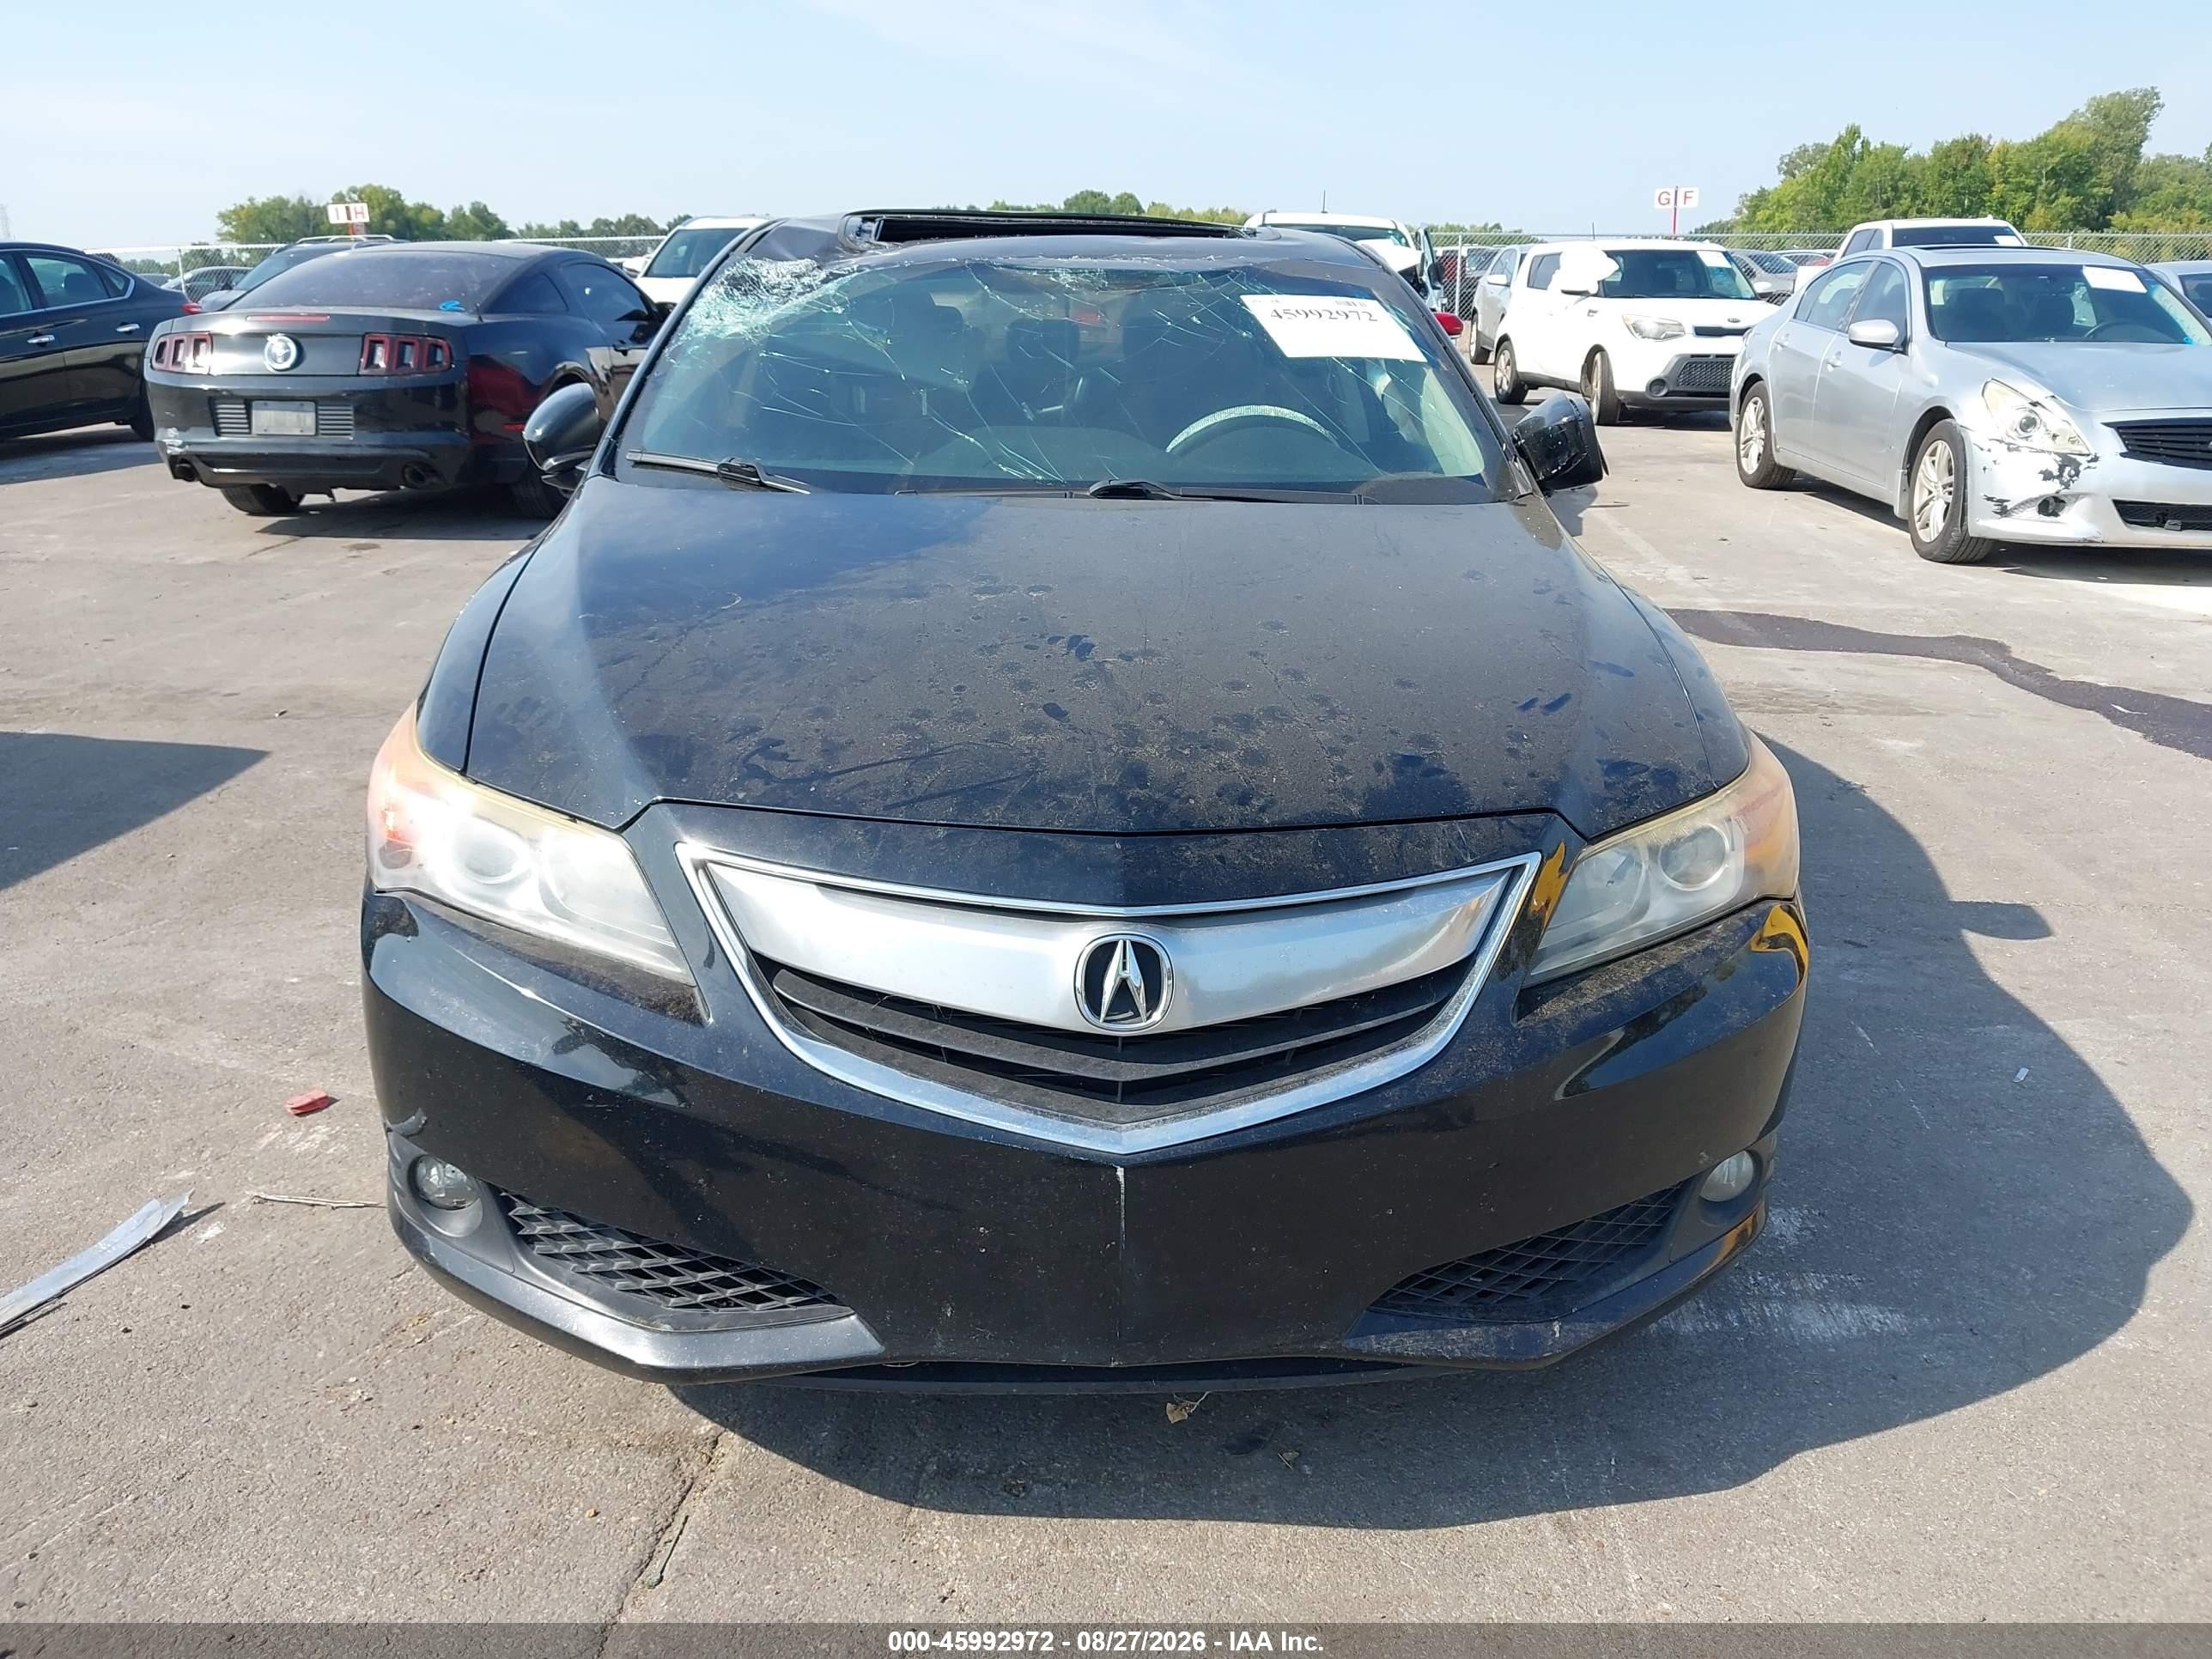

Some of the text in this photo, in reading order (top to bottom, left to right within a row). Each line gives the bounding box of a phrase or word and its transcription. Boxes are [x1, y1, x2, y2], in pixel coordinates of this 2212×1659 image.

[1657, 190, 1694, 206] G F
[354, 205, 365, 220] H
[1270, 308, 1379, 322] 45992972
